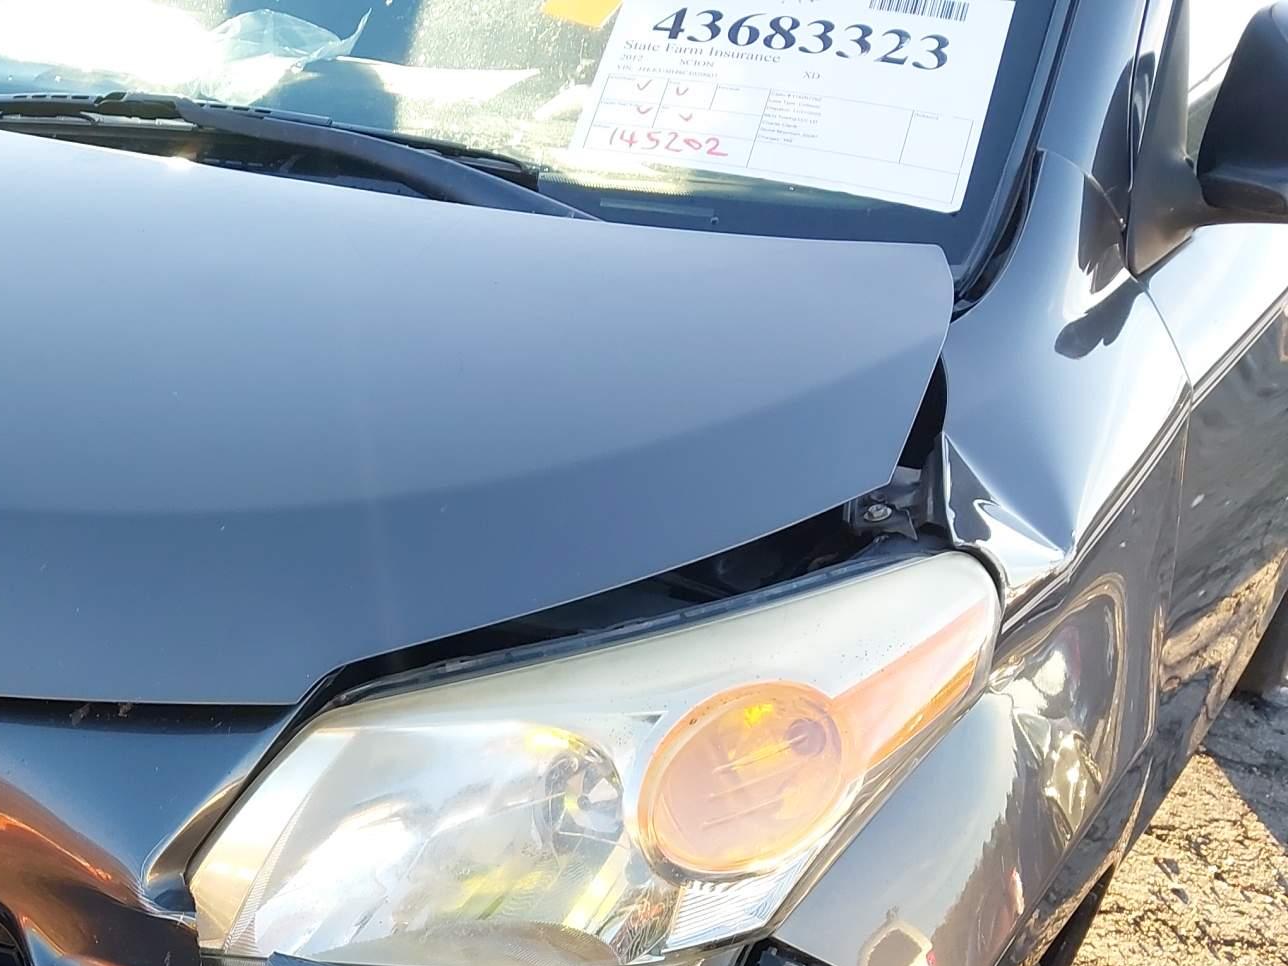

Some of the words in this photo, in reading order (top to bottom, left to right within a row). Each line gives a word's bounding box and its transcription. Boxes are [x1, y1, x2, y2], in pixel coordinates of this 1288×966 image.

[623, 39, 661, 53] State
[665, 42, 704, 56] Farm
[709, 46, 781, 64] Insurance
[652, 7, 950, 70] 43683323
[679, 58, 715, 68] SCION
[802, 71, 822, 80] XD
[609, 126, 729, 157] 145202
